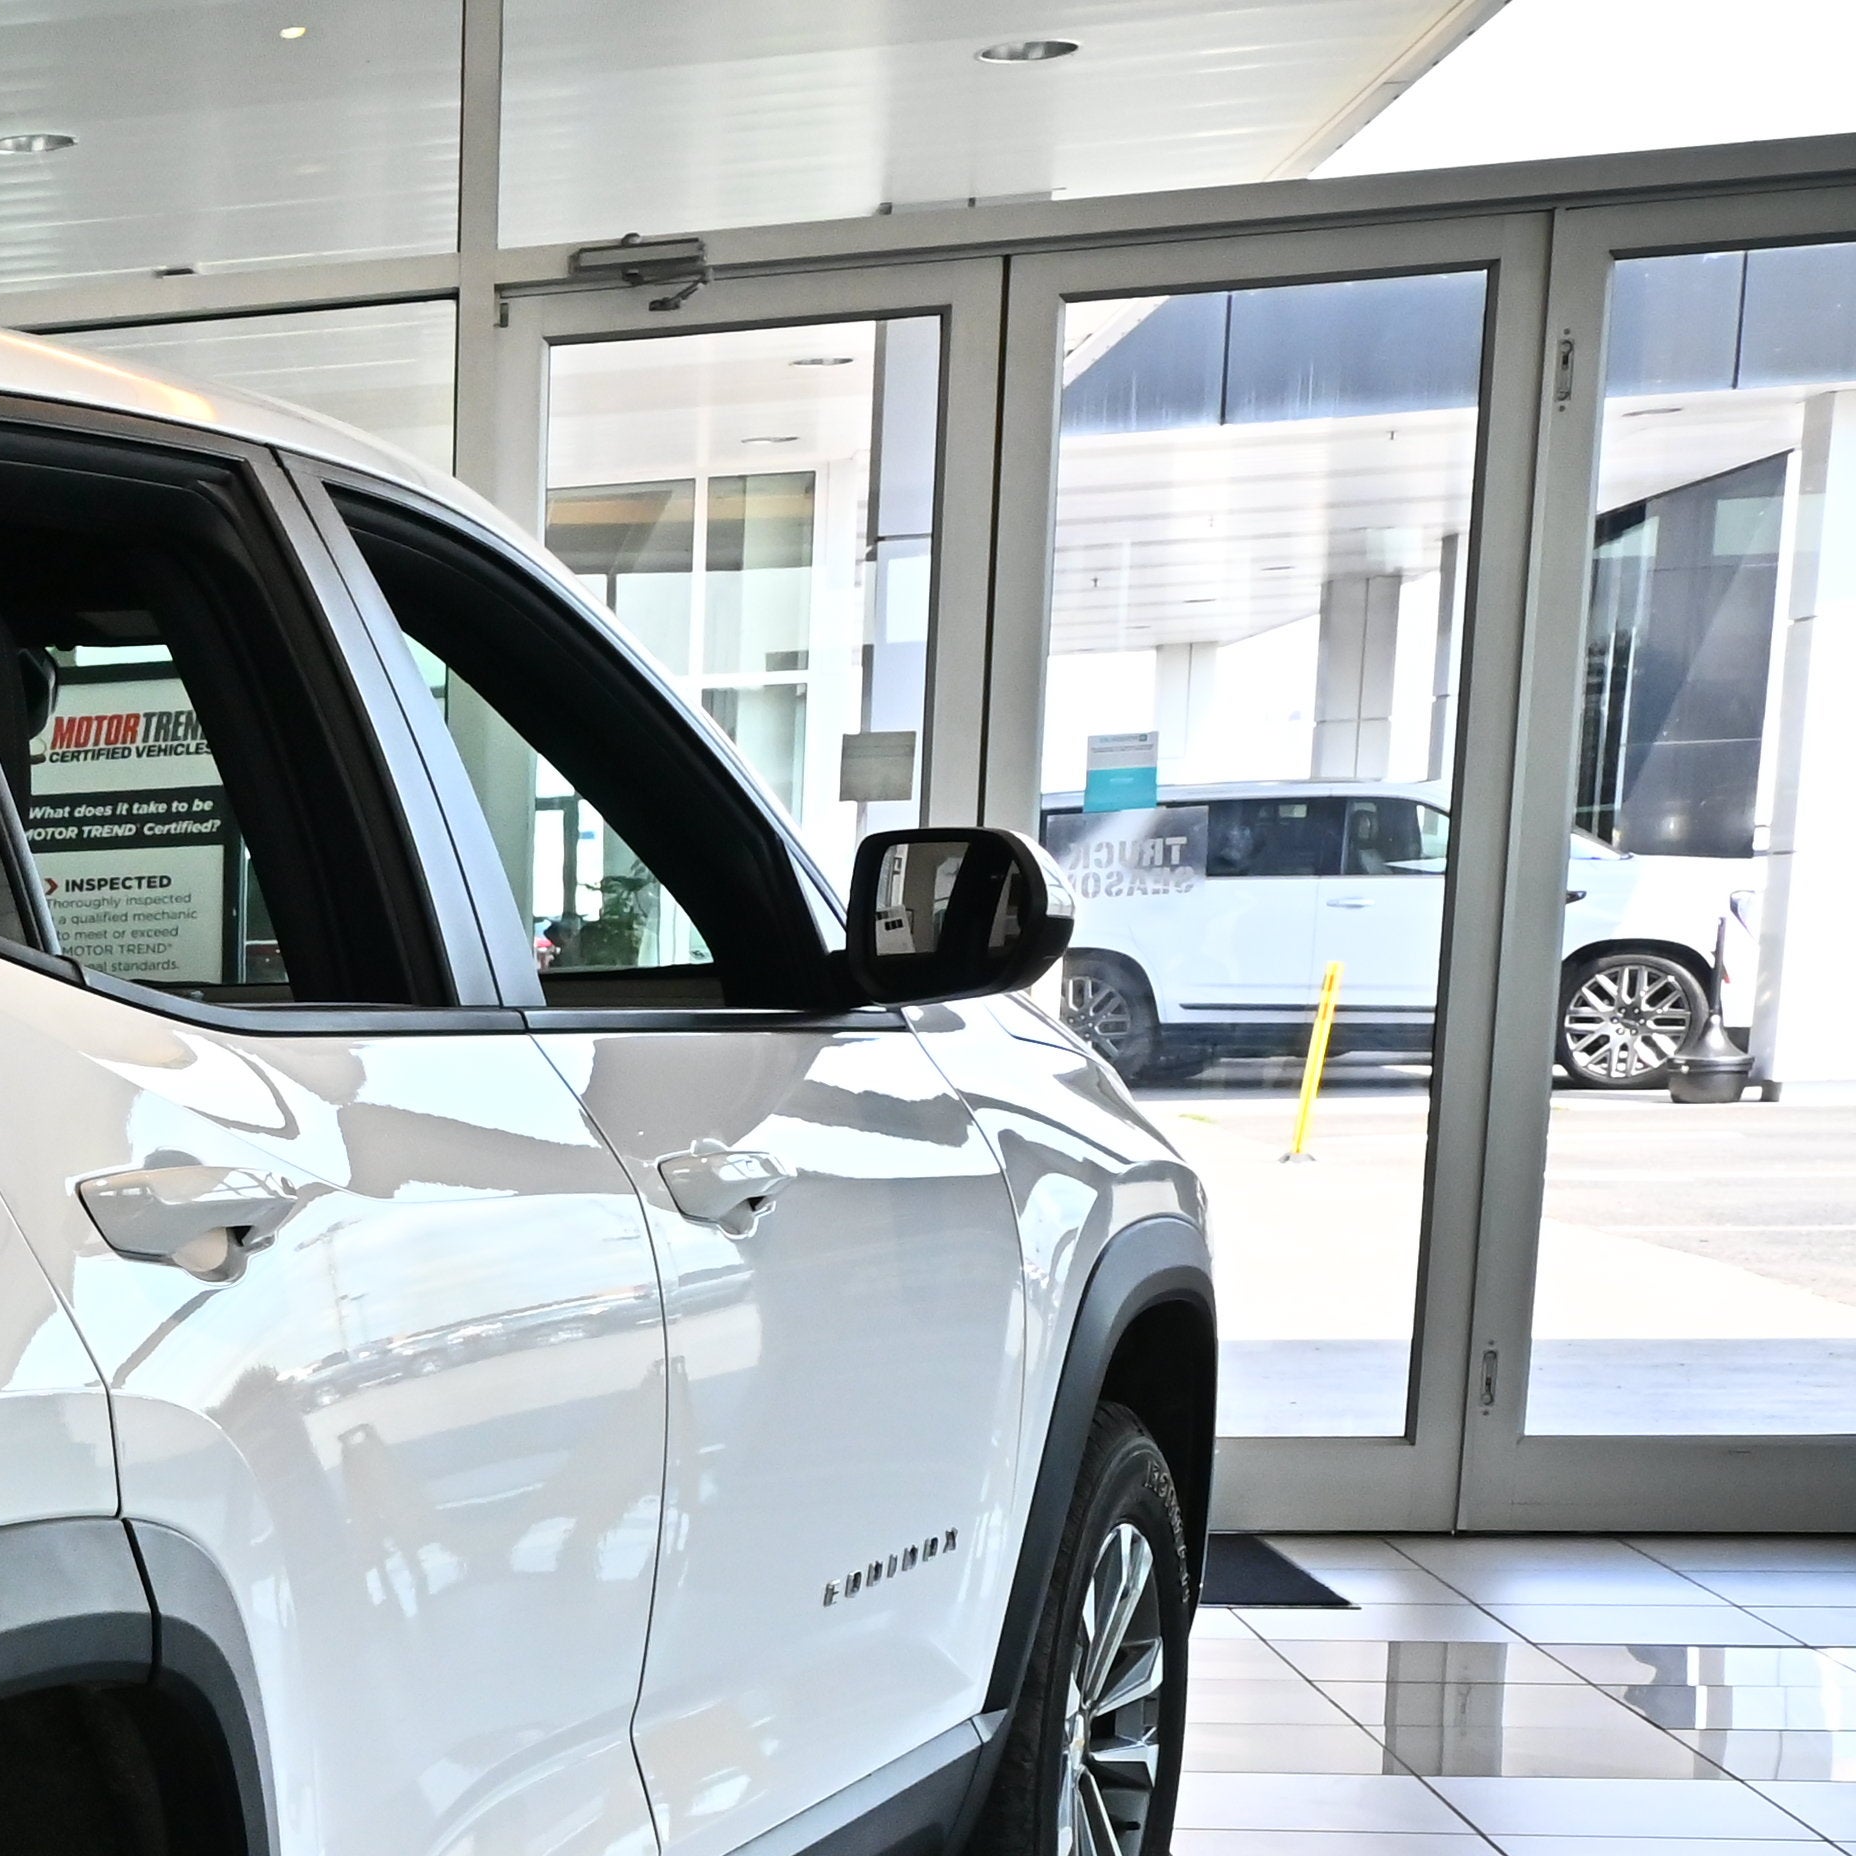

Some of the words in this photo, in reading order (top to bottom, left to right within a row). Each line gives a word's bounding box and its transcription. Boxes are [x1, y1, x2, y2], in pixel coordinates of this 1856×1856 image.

[51, 713, 140, 750] MOTOR
[49, 749, 132, 763] CERTIFIED
[29, 806, 70, 820] What
[74, 804, 112, 818] does
[116, 802, 127, 815] it
[132, 801, 167, 815] take
[171, 801, 188, 812] to
[192, 799, 213, 811] be
[143, 819, 221, 836] Certified?
[65, 875, 172, 893] INSPECTED
[126, 893, 192, 906] inspected
[58, 916, 67, 925] a
[71, 912, 128, 926] qualified
[133, 909, 198, 921] mechanic
[57, 930, 70, 941] to
[75, 929, 108, 940] meet
[113, 929, 126, 939] or
[131, 926, 179, 938] exceed
[61, 944, 113, 958] MOTOR
